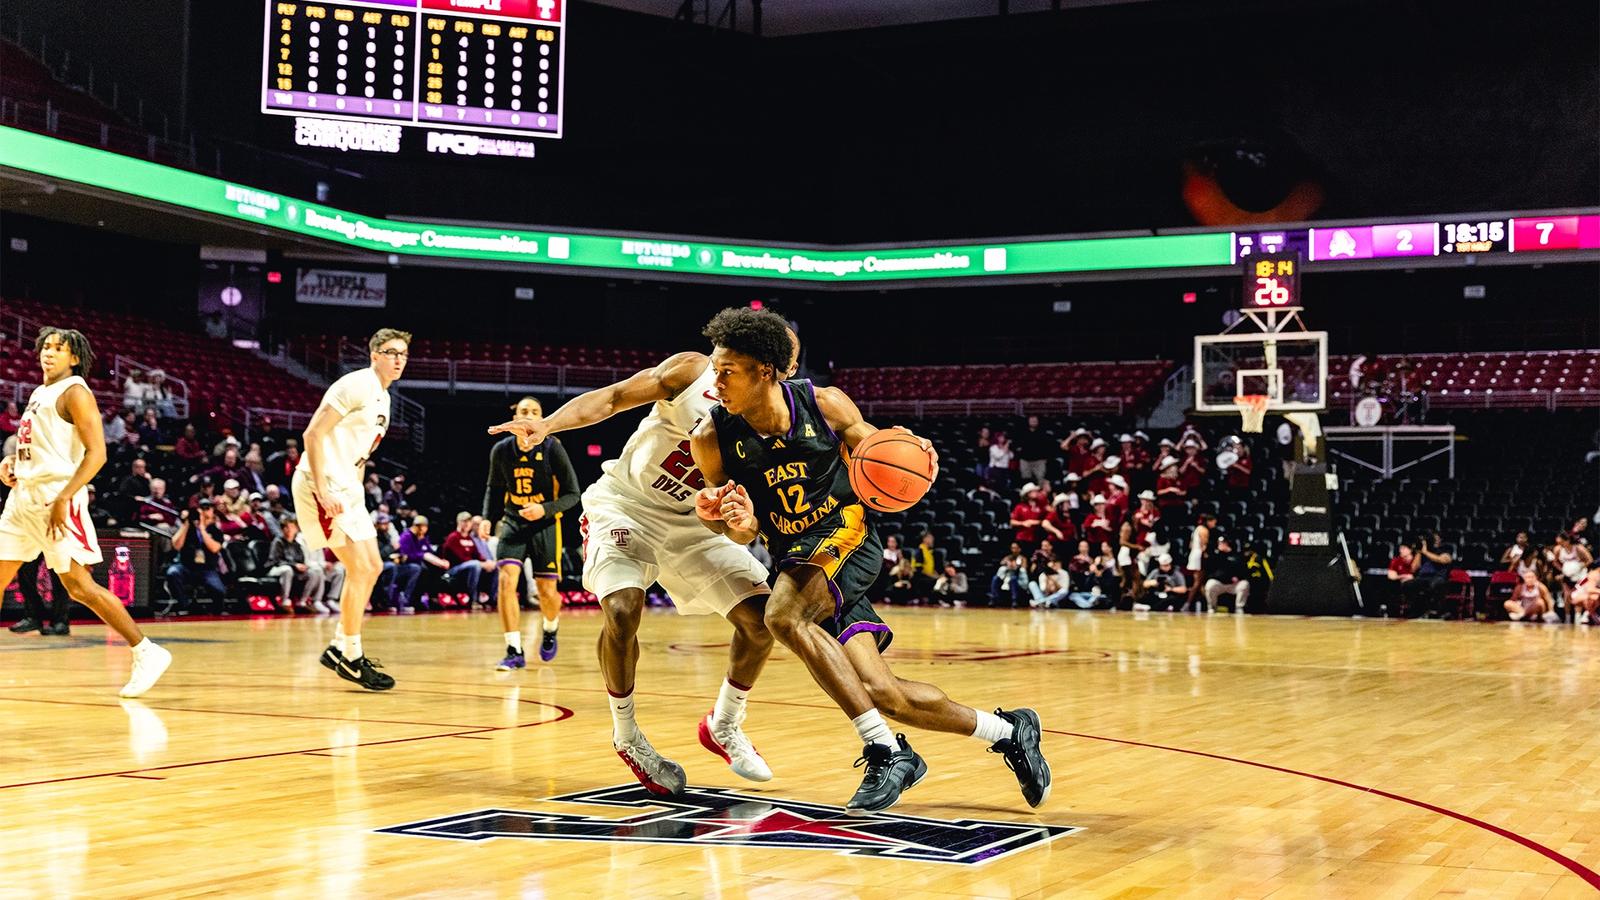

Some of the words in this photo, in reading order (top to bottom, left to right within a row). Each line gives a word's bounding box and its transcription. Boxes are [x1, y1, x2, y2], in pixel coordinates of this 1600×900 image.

[368, 27, 375, 39] 1
[396, 30, 403, 42] 1
[487, 39, 494, 50] 1
[459, 51, 466, 62] 1
[305, 208, 355, 239] Brewing
[421, 230, 538, 254] Communities
[1396, 230, 1414, 251] 2
[1444, 222, 1505, 243] 18:15
[1536, 223, 1554, 245] 7
[722, 251, 791, 274] Brewing
[791, 255, 863, 277] Stronger
[863, 252, 970, 273] Communities
[317, 274, 367, 290] TEMPLE
[1255, 278, 1289, 305] 26
[298, 284, 386, 301] ATHLETICS
[804, 424, 816, 438] A
[736, 441, 746, 459] C
[764, 462, 808, 487] EAST
[516, 478, 533, 495] 15
[651, 474, 693, 501] OWLS
[897, 476, 913, 496] T
[777, 484, 812, 515] 12
[769, 495, 840, 536] CAROLINA
[611, 528, 630, 547] T
